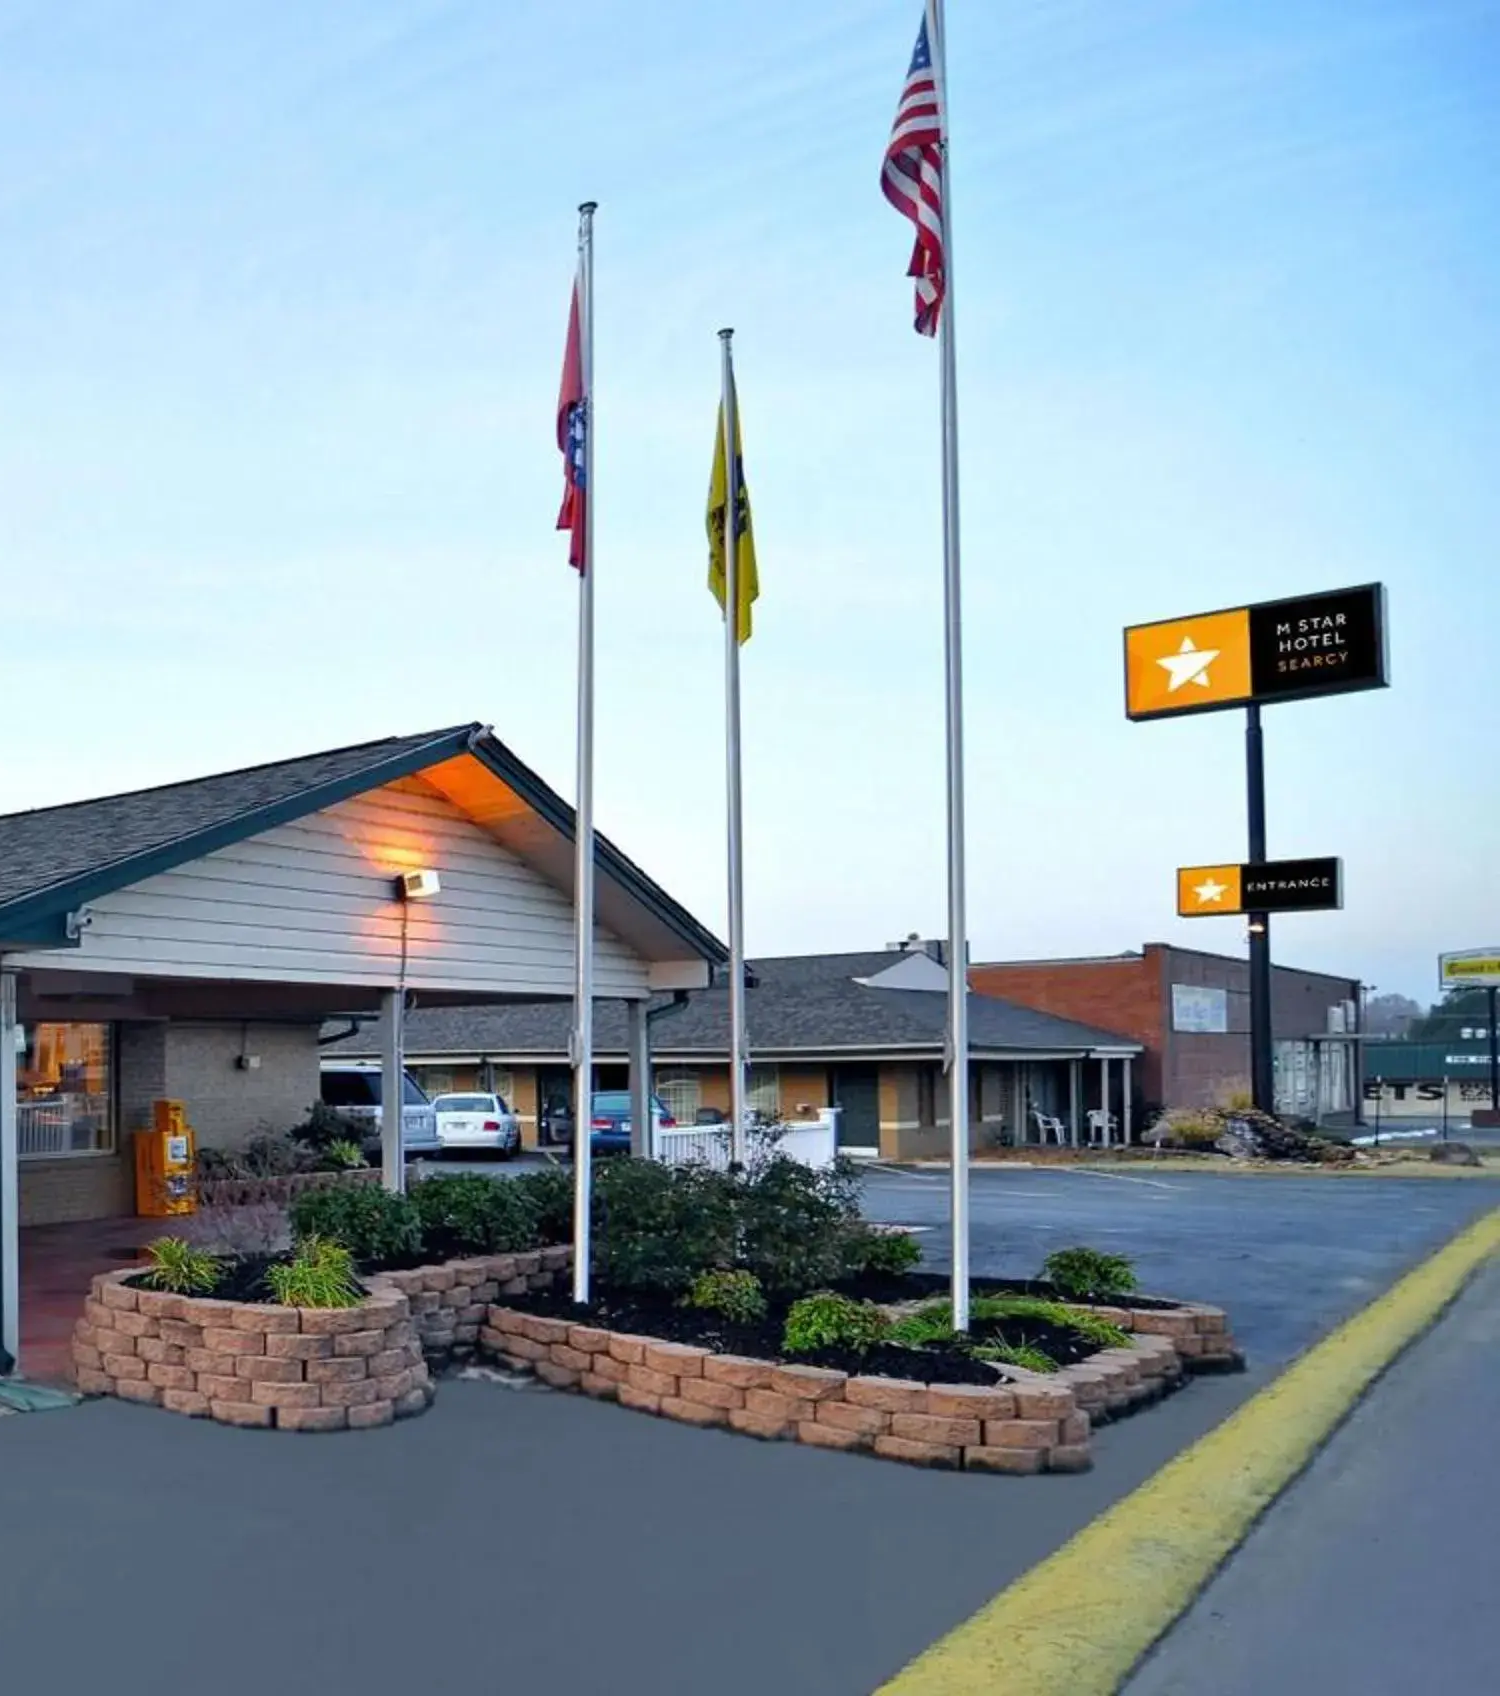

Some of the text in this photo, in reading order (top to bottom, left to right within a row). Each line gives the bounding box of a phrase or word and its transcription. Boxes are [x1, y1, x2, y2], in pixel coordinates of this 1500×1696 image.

[1276, 613, 1346, 635] M STAR
[1280, 632, 1345, 652] HOTEL
[1277, 652, 1348, 672] SEARCY
[1247, 877, 1329, 891] ENTRANCE
